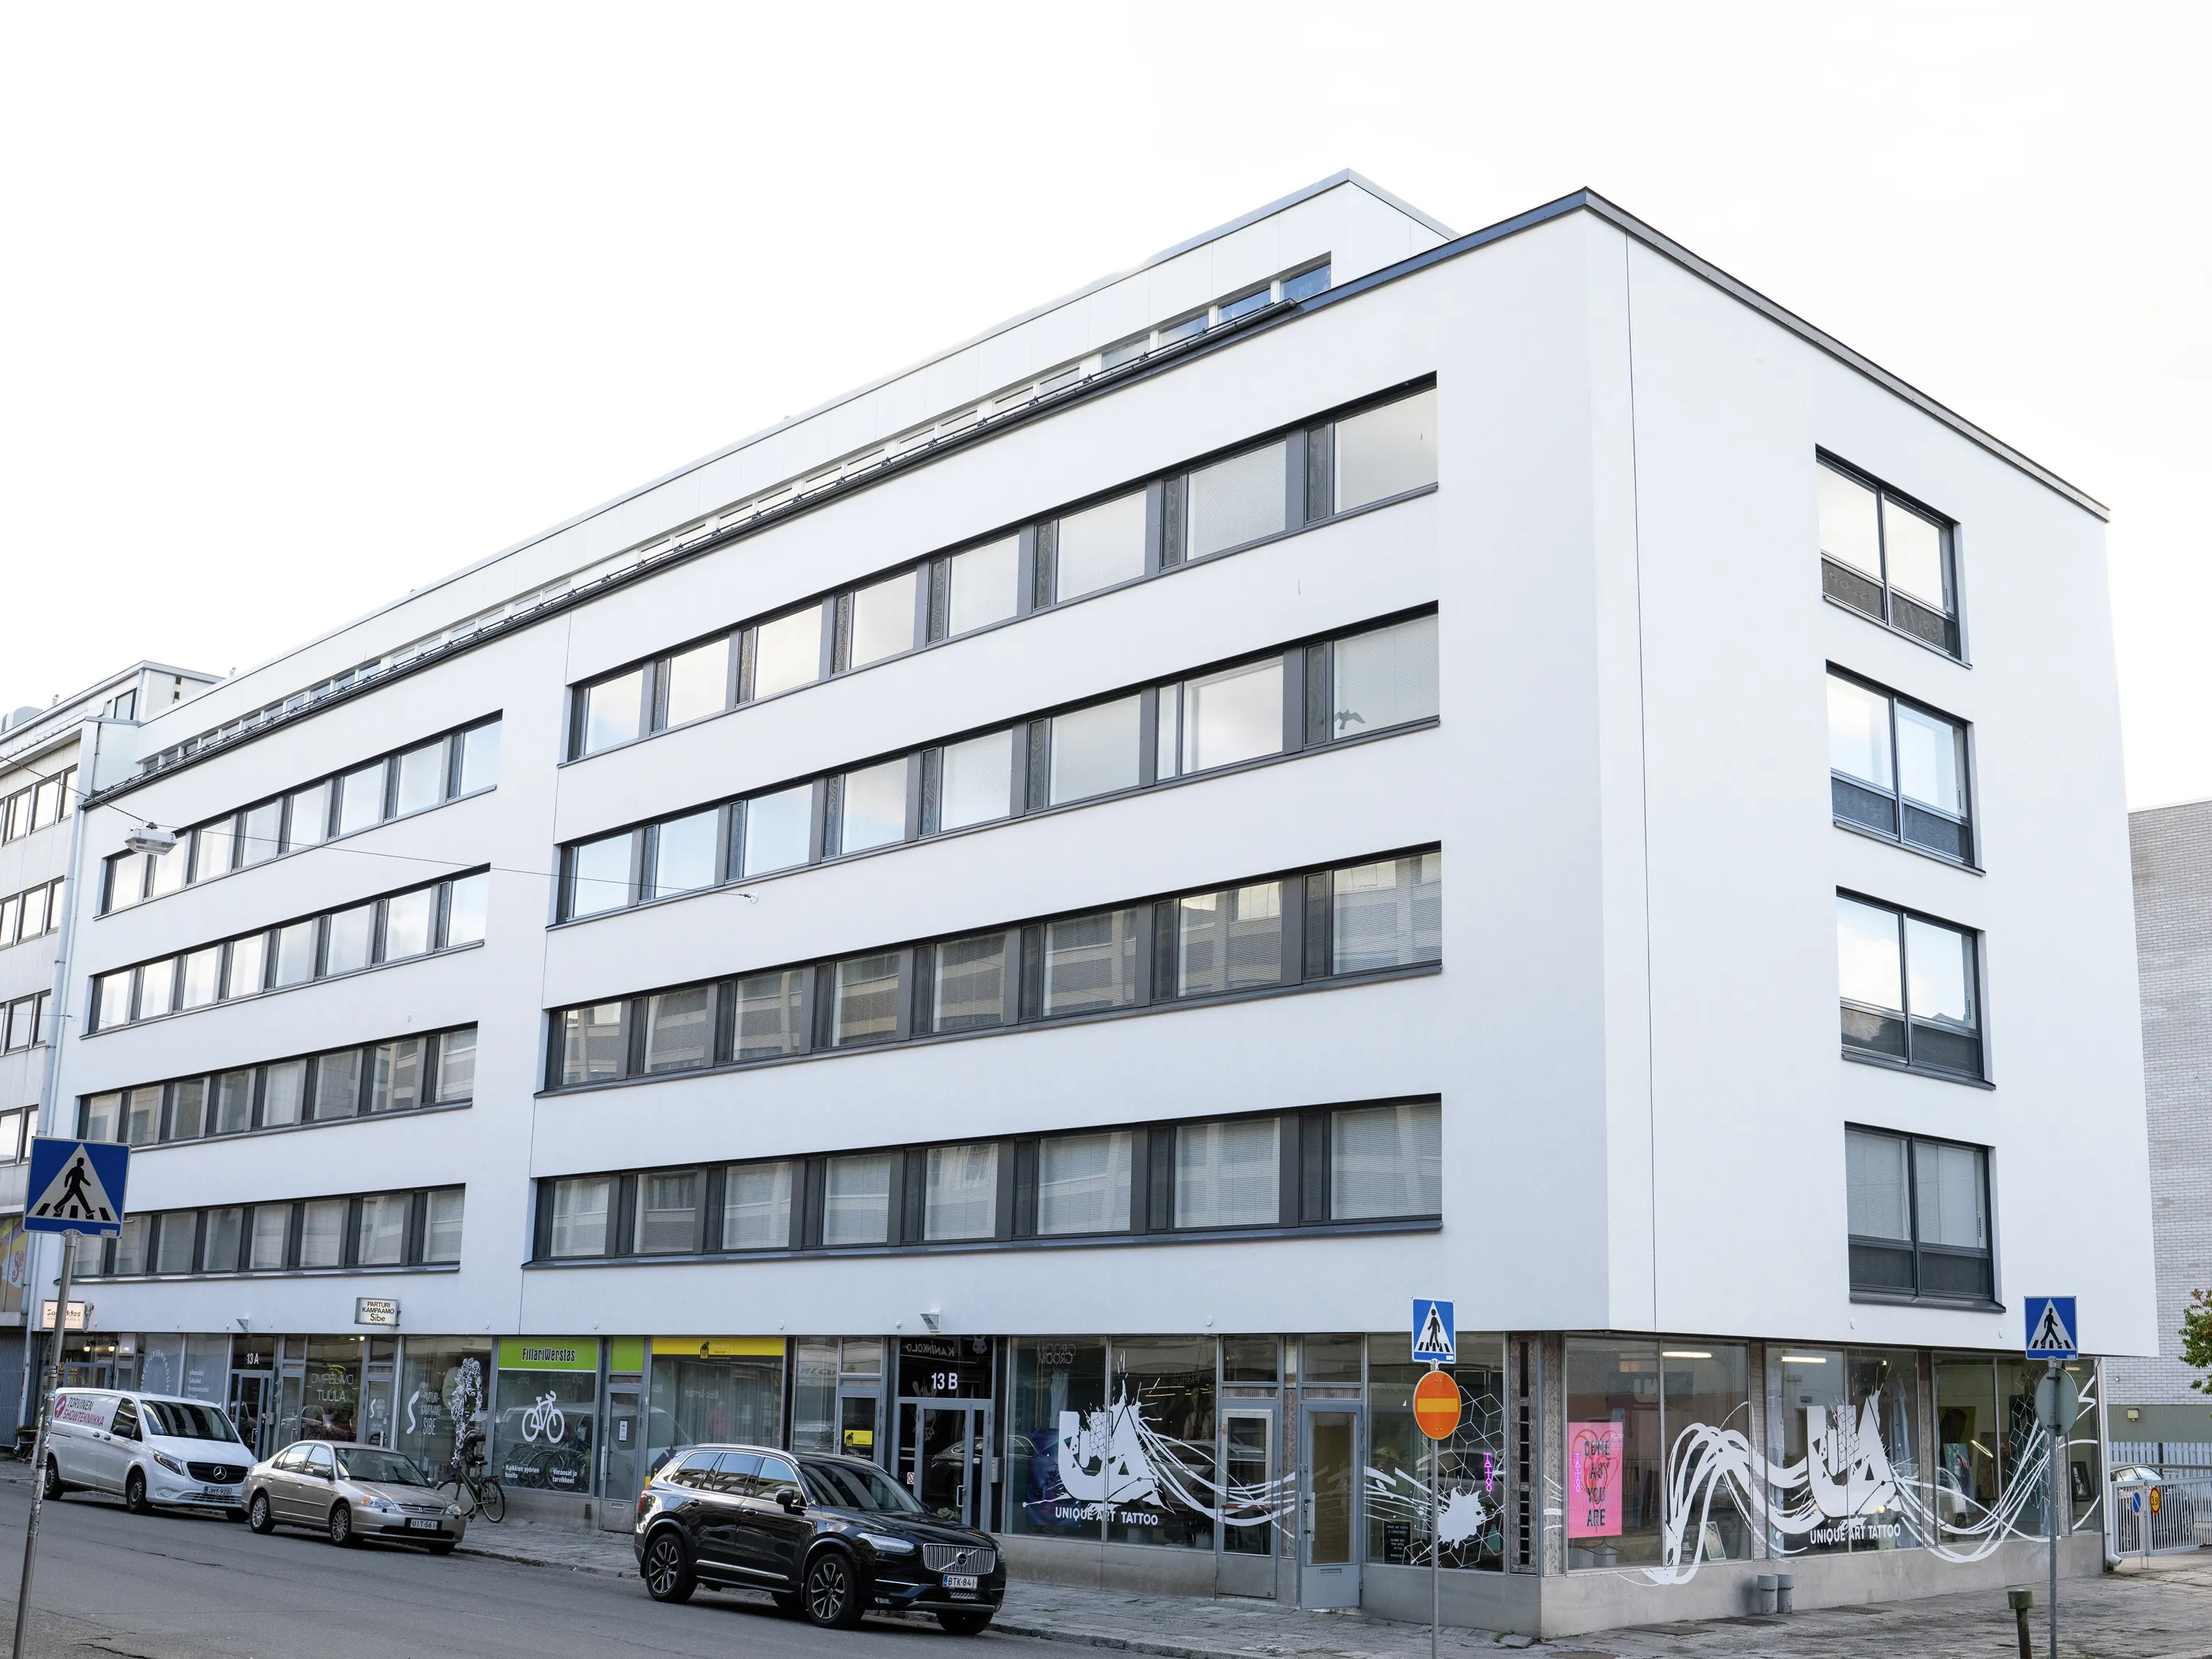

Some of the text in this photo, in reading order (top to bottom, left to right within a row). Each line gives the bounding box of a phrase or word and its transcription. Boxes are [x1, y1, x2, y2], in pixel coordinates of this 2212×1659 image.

[370, 1313, 386, 1322] Sibe
[246, 1352, 259, 1364] 13 A
[522, 1347, 575, 1362] FillariWerstas
[931, 1372, 958, 1390] 13 B
[317, 1389, 346, 1401] TUULA
[68, 1398, 94, 1411] TORVINEN
[420, 1405, 442, 1416] KAMPAAMO
[63, 1409, 104, 1426] SHOWTEKNIIKKA
[423, 1417, 436, 1435] SIBE
[1584, 1440, 1611, 1456] COME
[1484, 1452, 1492, 1492] TATTOO
[1590, 1462, 1604, 1479] AS
[1587, 1487, 1606, 1502] YOU
[1055, 1507, 1158, 1525] UNIQUE ART TATTOO
[1587, 1509, 1606, 1527] ARE
[1810, 1522, 1901, 1545] UNIQUE ART TATTOO
[948, 1577, 975, 1586] BTK-841
